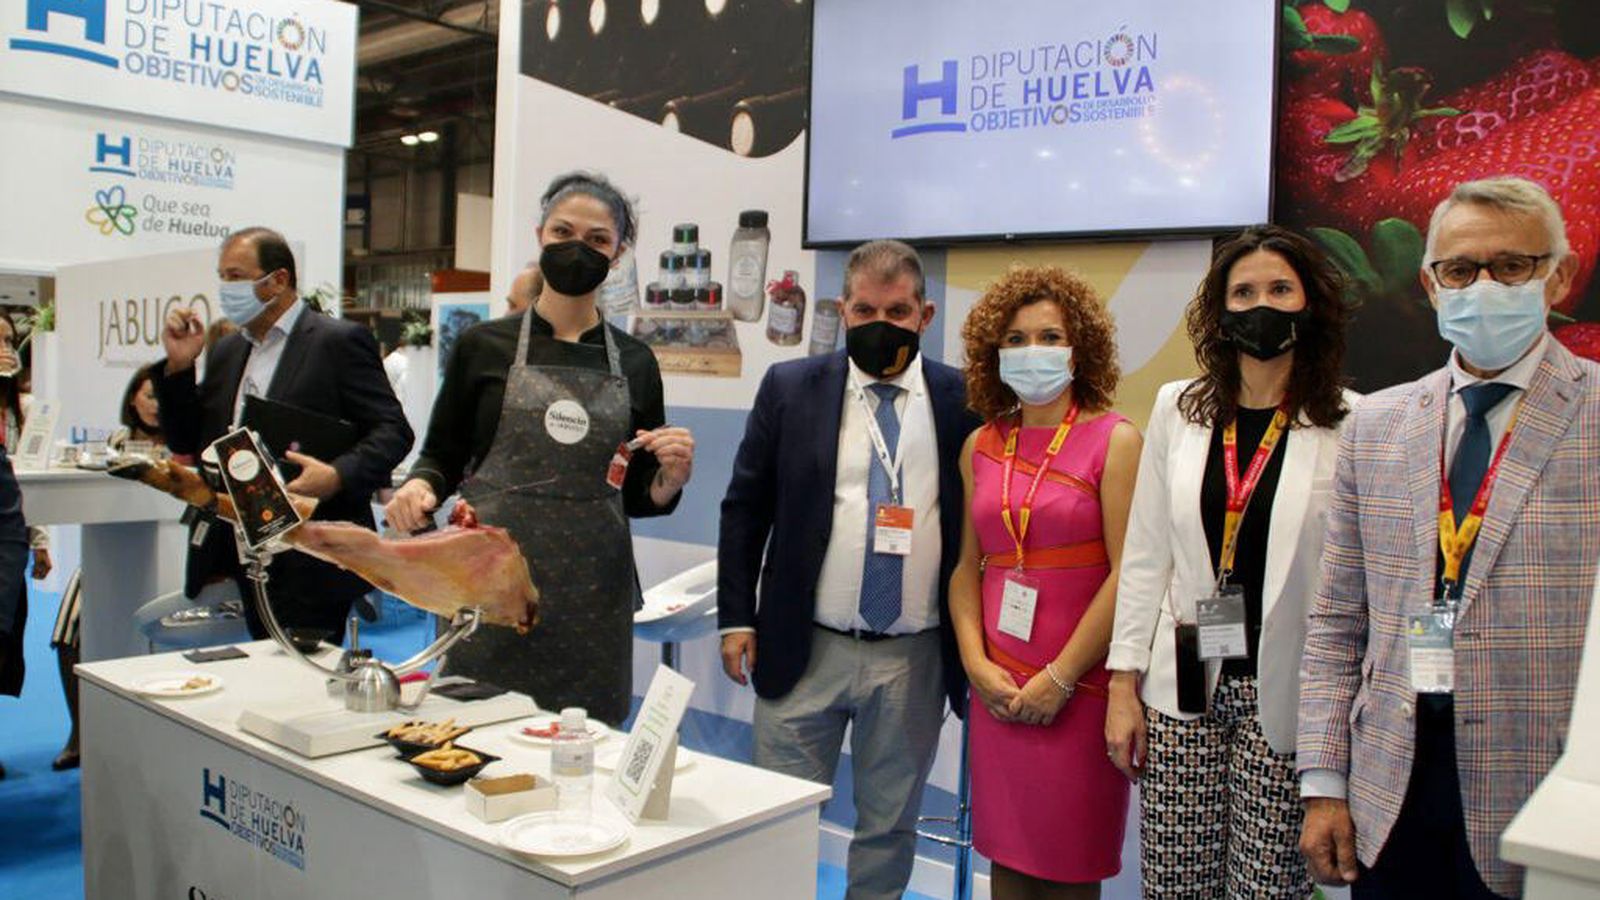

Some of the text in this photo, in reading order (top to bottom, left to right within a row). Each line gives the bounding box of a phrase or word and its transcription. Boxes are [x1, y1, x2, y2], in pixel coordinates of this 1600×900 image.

[124, 19, 323, 84] DE HUELVA
[971, 25, 1158, 81] DIPUTACIÓN
[124, 52, 254, 95] OBJETIVOS
[970, 66, 1155, 111] DE HUELVA
[970, 103, 1082, 132] OBJETIVOS
[138, 138, 236, 164] DIPUTACIÓN
[138, 153, 234, 178] DE HUELVA
[142, 194, 211, 218] Que sea
[142, 215, 230, 238] de Huelva
[230, 780, 306, 833] DIPUTACIÓN
[230, 801, 305, 855] DE HUELVA
